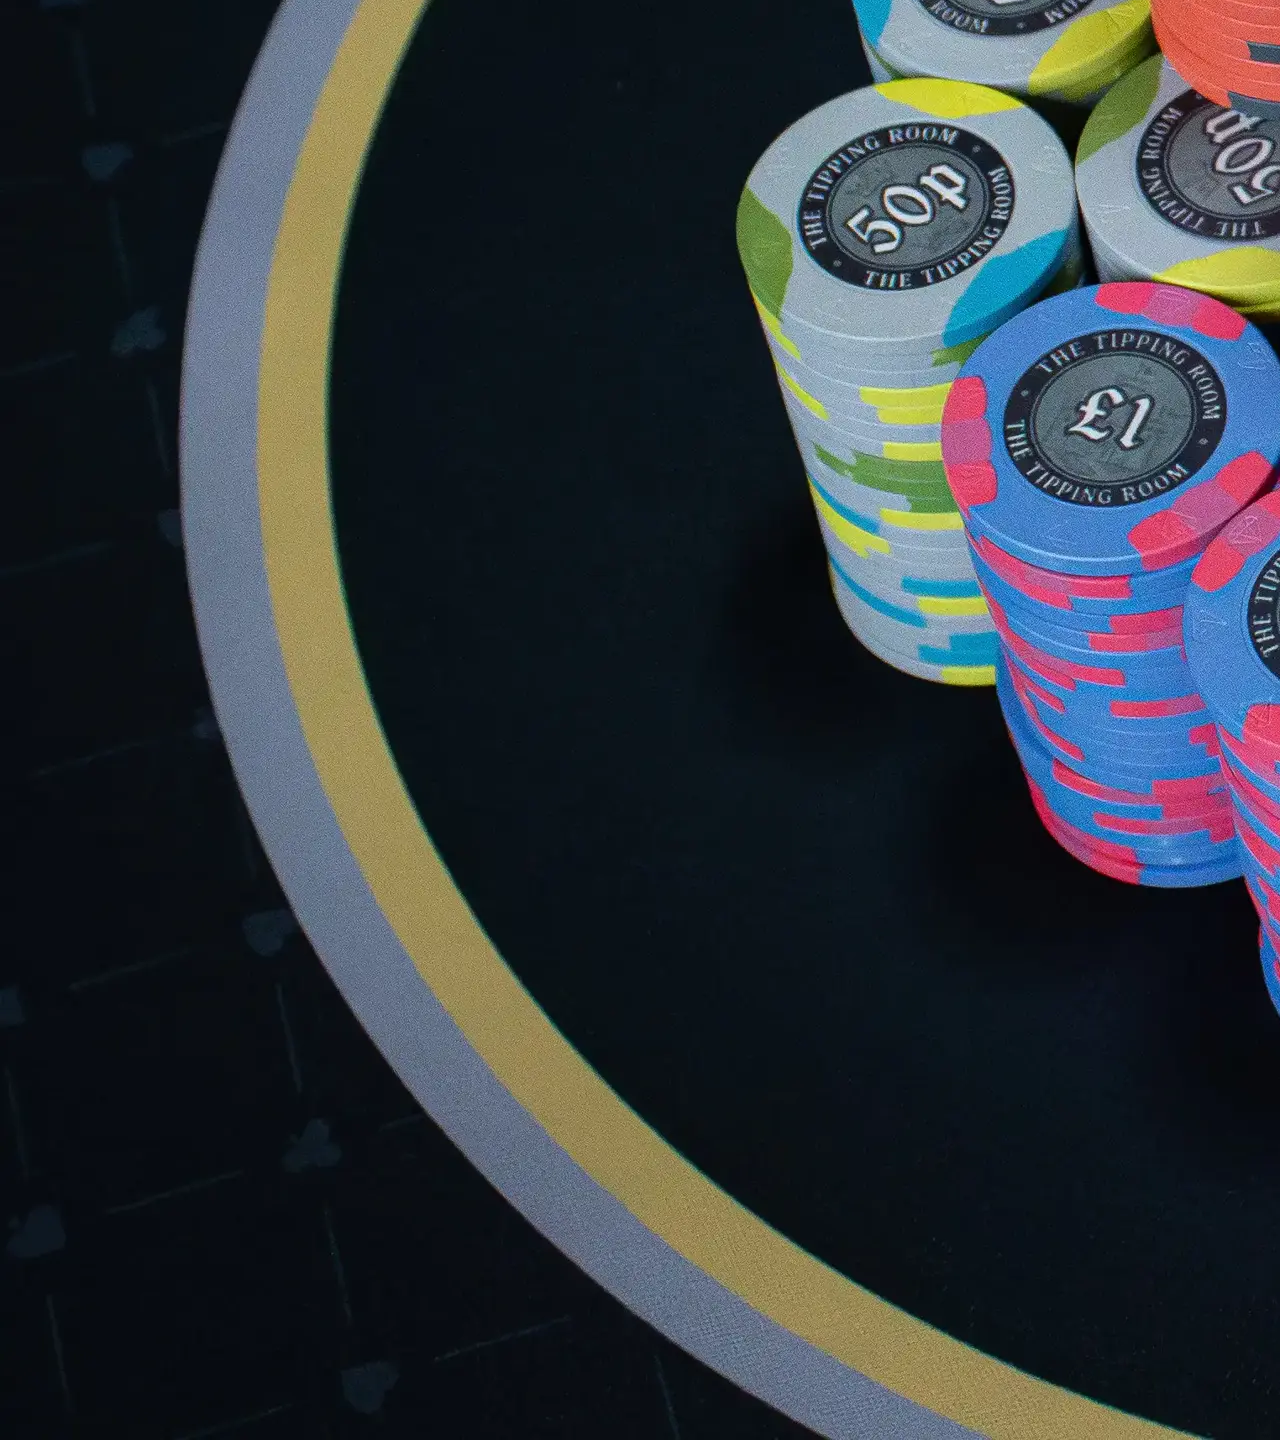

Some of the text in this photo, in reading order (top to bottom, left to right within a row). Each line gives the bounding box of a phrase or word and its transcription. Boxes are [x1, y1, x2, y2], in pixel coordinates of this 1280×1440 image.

[803, 127, 957, 249] THE TIPPING ROOM
[847, 164, 966, 254] 50p
[863, 165, 1010, 287] THE TIPPING ROOM
[1038, 332, 1221, 420] THE TIPPING ROOM
[1069, 388, 1151, 448] £1
[1008, 419, 1190, 503] THE TIPPING ROOM
[1253, 613, 1280, 654] THE
